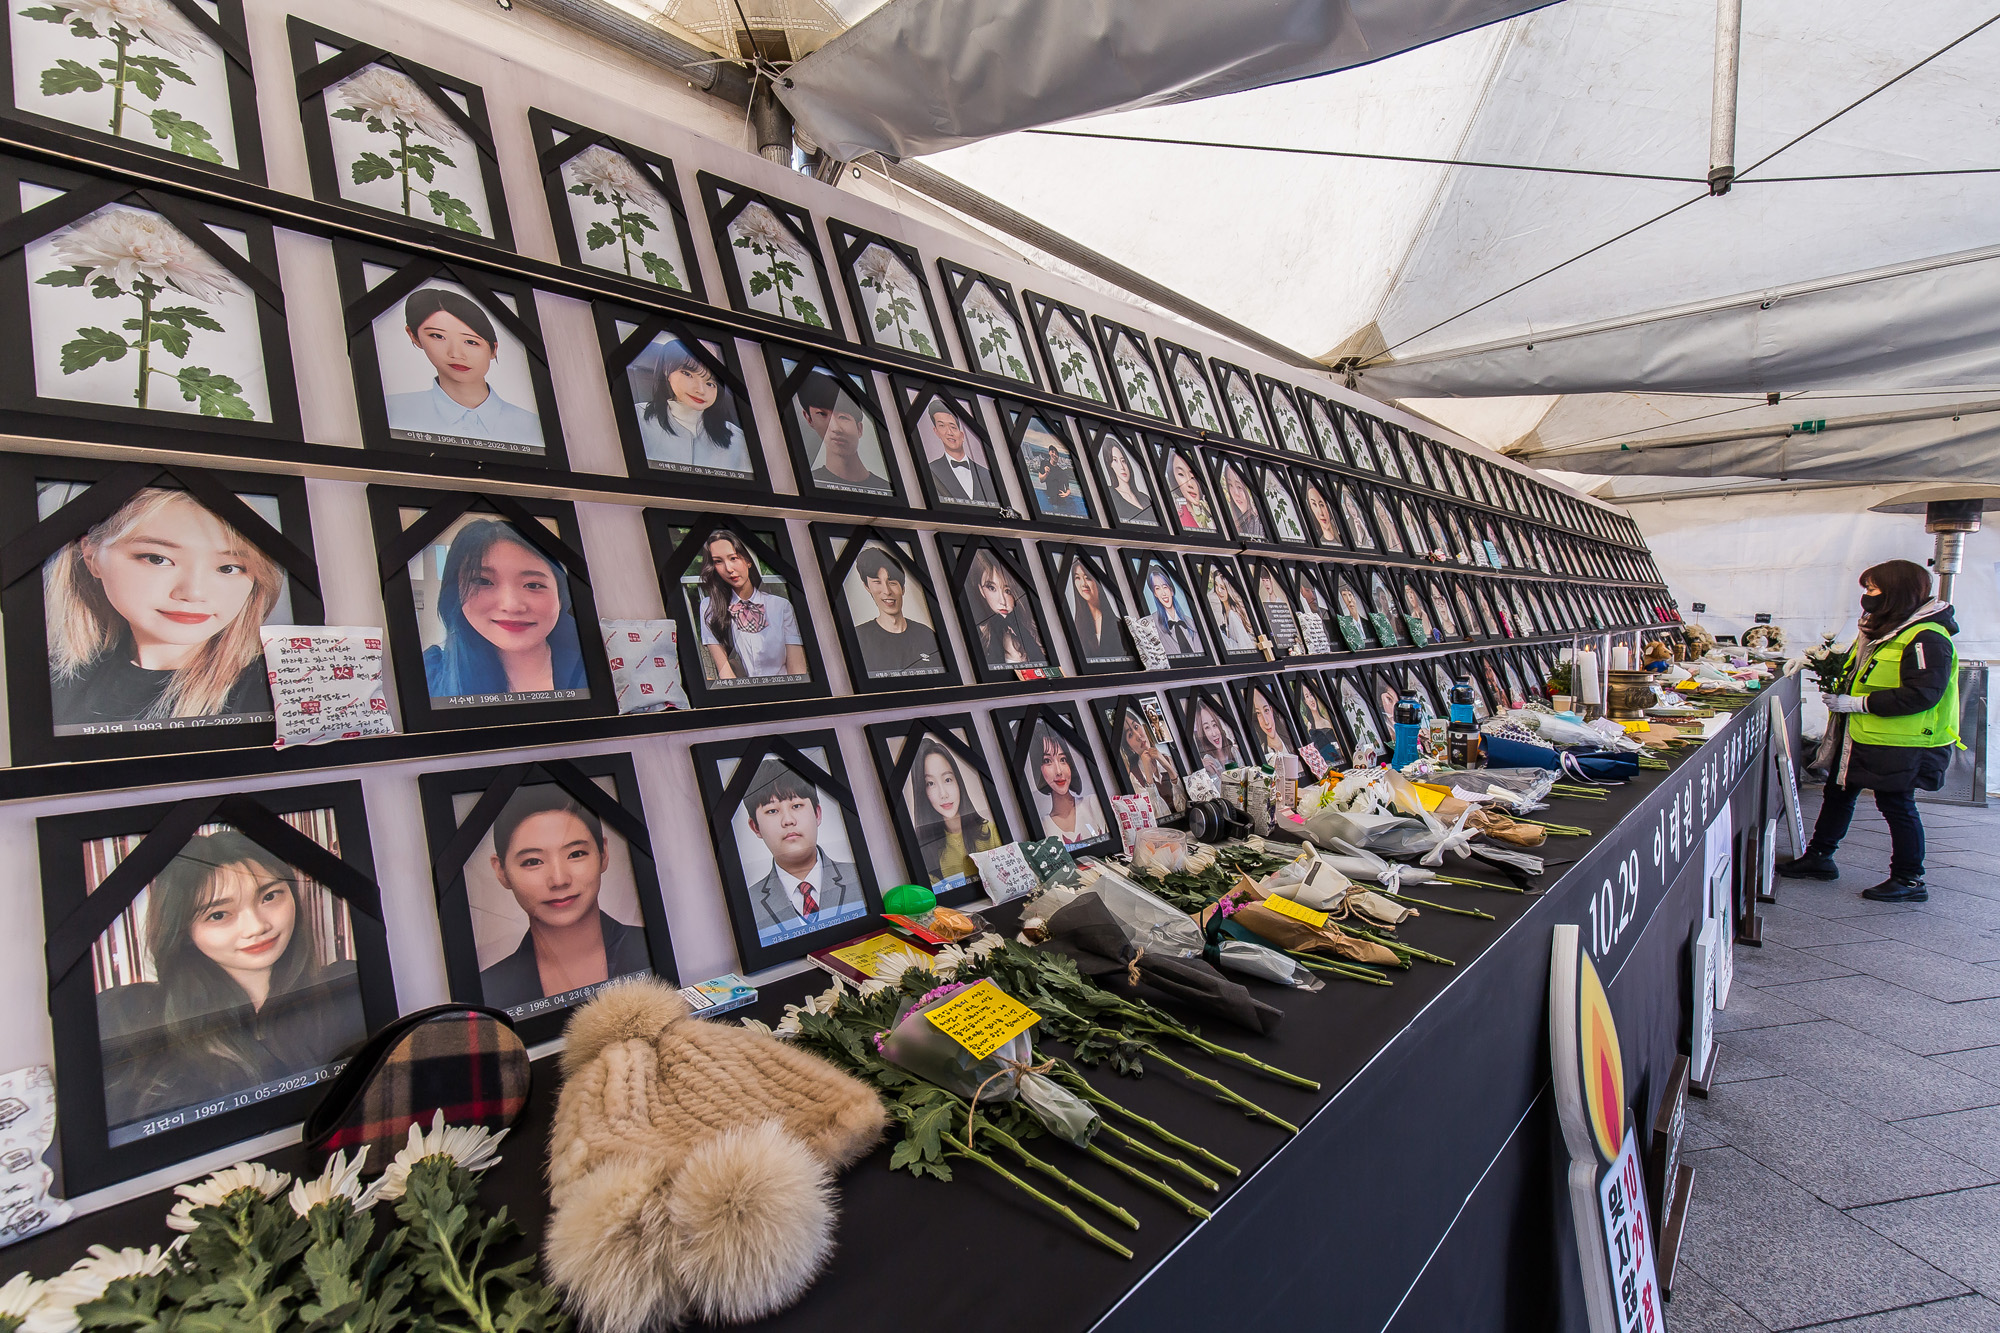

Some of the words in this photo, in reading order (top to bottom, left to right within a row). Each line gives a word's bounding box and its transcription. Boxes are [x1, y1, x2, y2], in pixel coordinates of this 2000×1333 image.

[437, 435, 458, 444] 1996.
[460, 438, 472, 446] 10.
[509, 444, 520, 452] 10.
[480, 694, 501, 703] 1996.
[503, 694, 515, 702] 12.
[517, 692, 552, 701] 11-2022.
[553, 691, 565, 699] 10.
[566, 690, 576, 698] 29
[1589, 849, 1640, 957] 10.29
[1653, 779, 1693, 885] 이태원
[1701, 752, 1718, 826] 참사
[1722, 727, 1742, 791] 희생자
[529, 999, 552, 1012] 1995.
[554, 995, 567, 1005] 04.
[142, 1113, 185, 1136] 김단이
[194, 1101, 229, 1121] 1997.
[233, 1094, 251, 1107] 10.
[255, 1076, 311, 1101] 05-2022.
[314, 1069, 331, 1082] 10.
[1623, 1153, 1645, 1274] 10.29
[1642, 1279, 1658, 1333] 참
